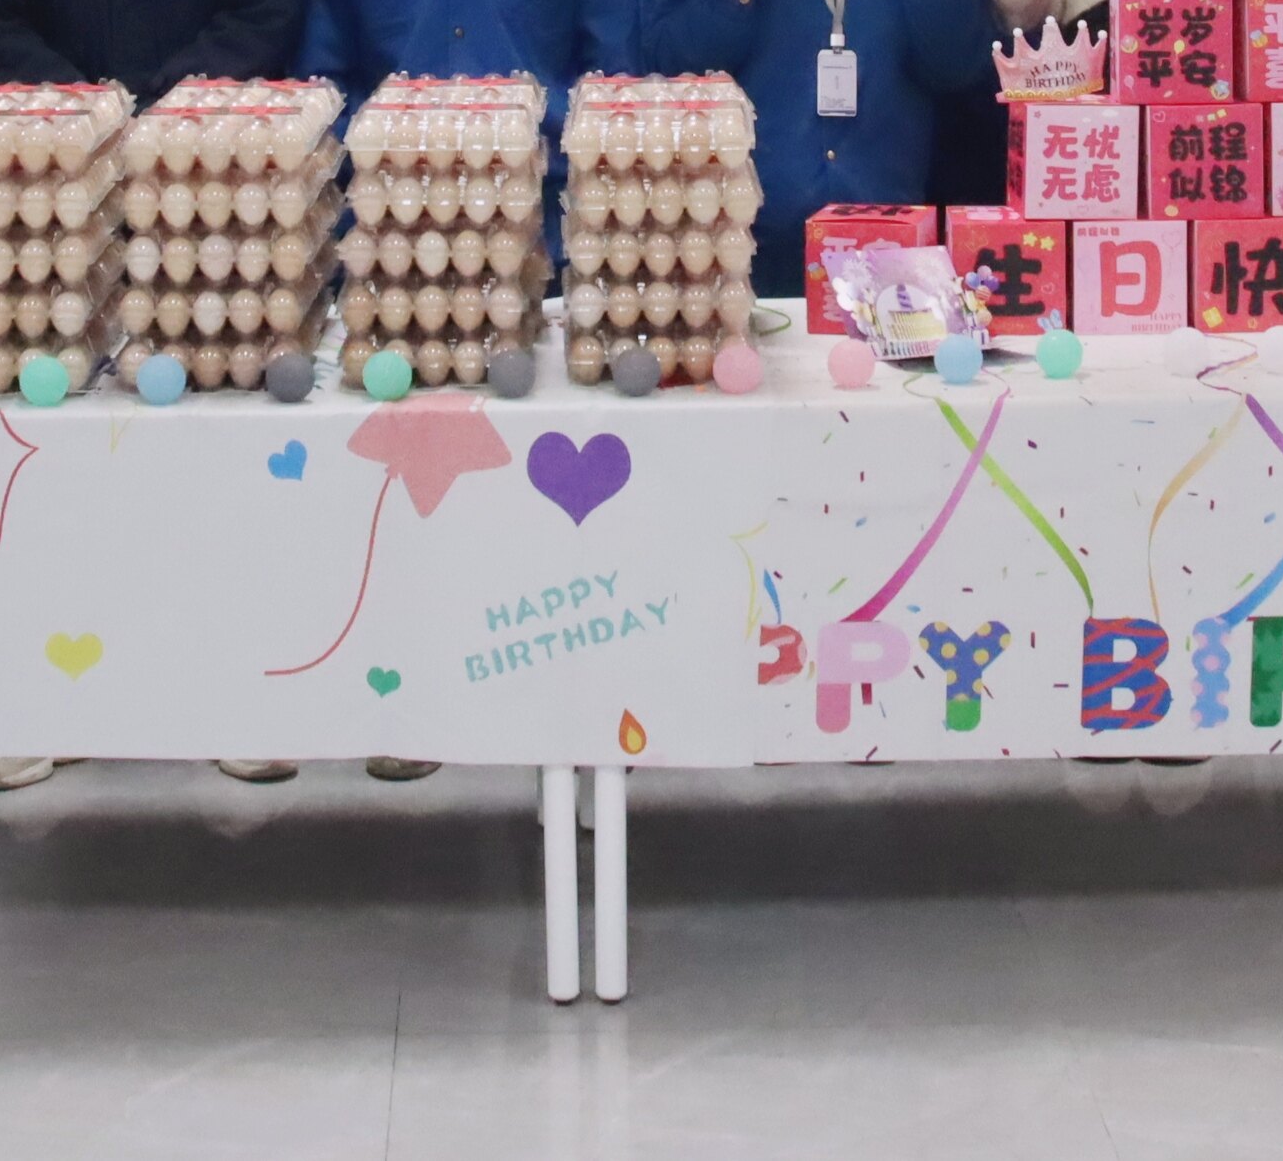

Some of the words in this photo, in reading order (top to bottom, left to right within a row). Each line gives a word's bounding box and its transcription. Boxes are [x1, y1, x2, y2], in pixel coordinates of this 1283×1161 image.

[1137, 6, 1216, 47] 岁岁
[1025, 72, 1086, 89] BIRTHDAY
[1030, 60, 1079, 78] HAPPY
[1137, 50, 1217, 89] 平安
[1042, 124, 1121, 159] 无忧
[1167, 122, 1248, 162] 前程
[1041, 163, 1121, 203] 无虑
[1167, 164, 1248, 204] 似锦
[485, 569, 618, 633] HAPPY
[465, 596, 669, 683] BIRTHDAY
